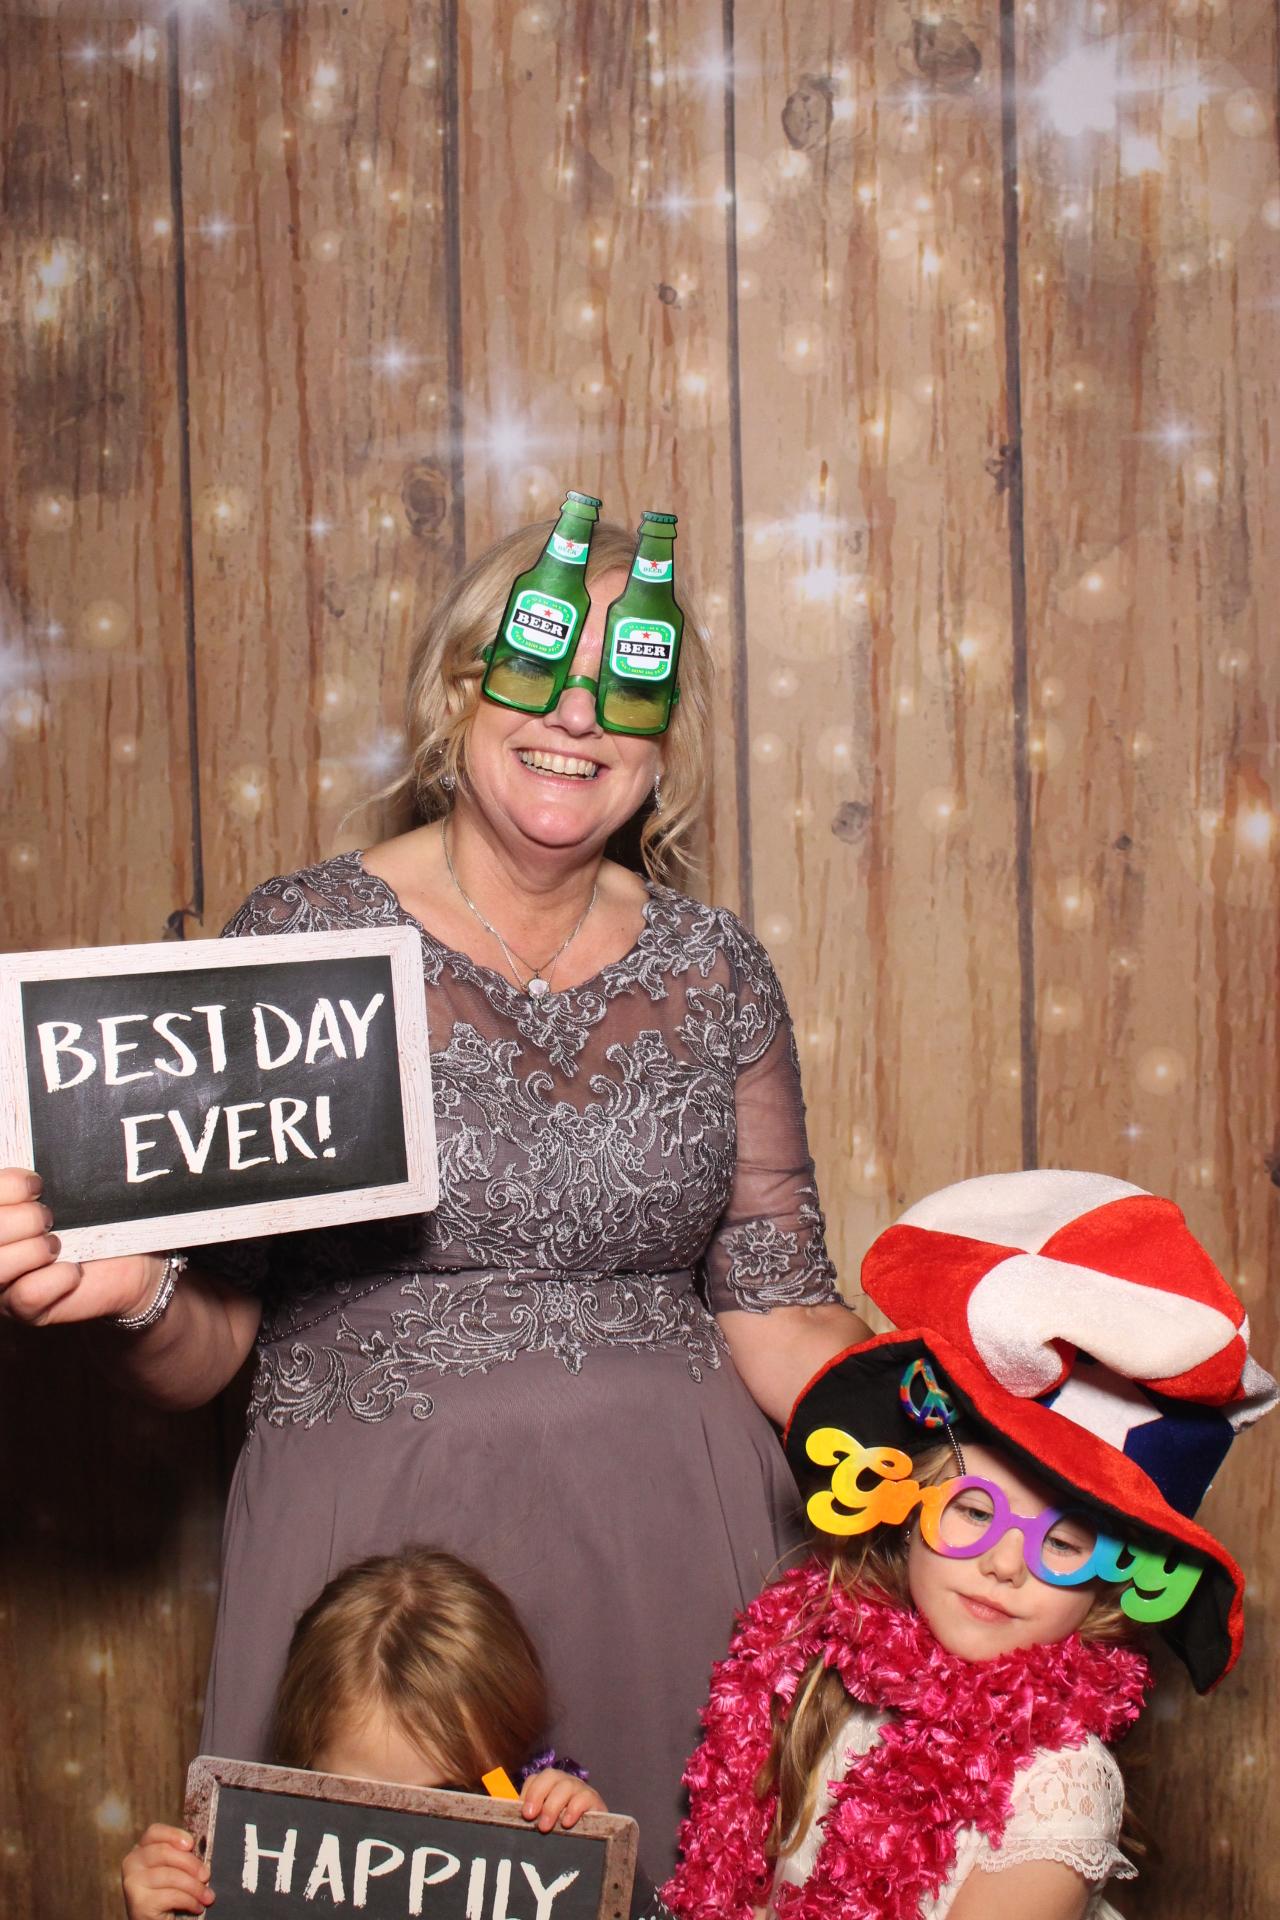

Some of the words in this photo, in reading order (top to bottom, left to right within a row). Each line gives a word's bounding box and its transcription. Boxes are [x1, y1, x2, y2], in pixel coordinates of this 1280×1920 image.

[516, 611, 563, 637] BEER
[619, 642, 666, 657] BEER
[37, 1004, 227, 1093] BEST
[252, 993, 385, 1071] DAY
[120, 1096, 337, 1183] EVER!
[241, 1823, 580, 1920] HAPPILY
